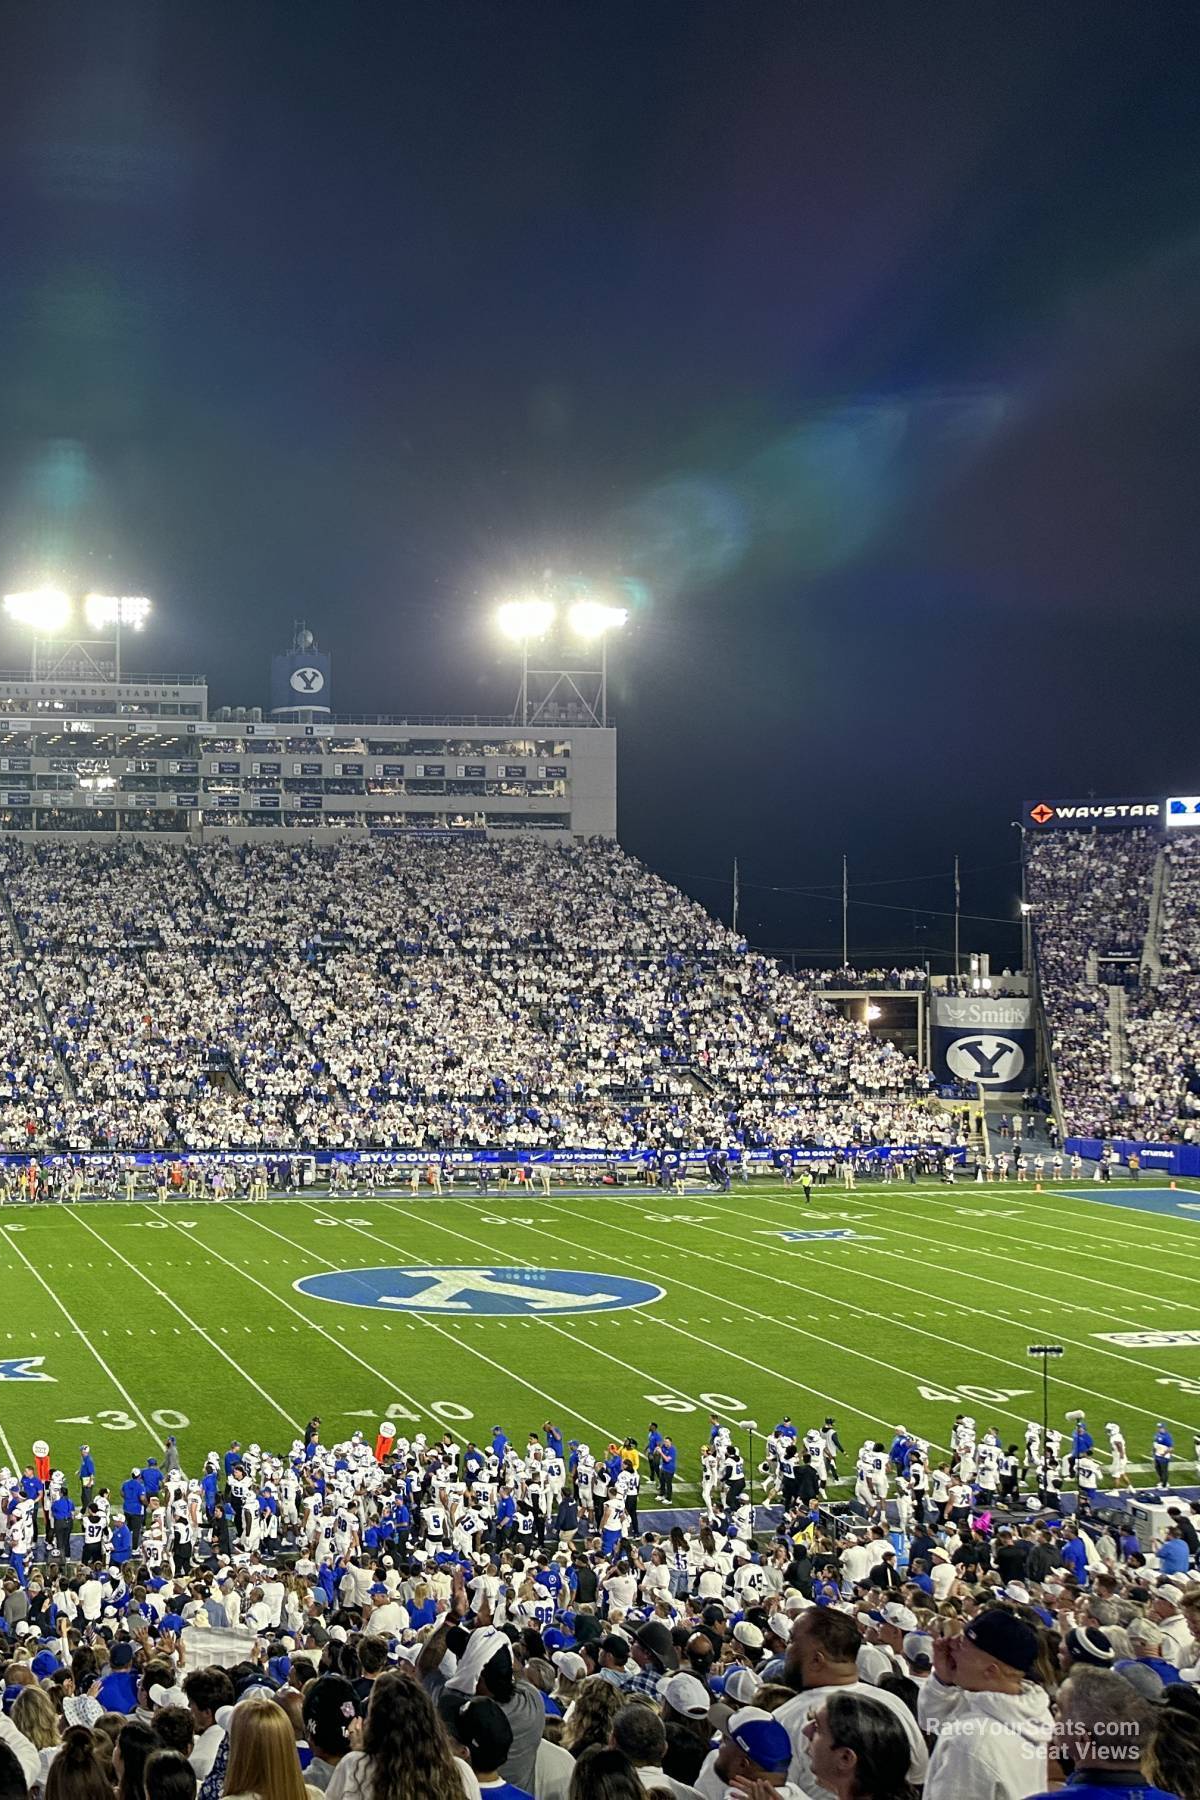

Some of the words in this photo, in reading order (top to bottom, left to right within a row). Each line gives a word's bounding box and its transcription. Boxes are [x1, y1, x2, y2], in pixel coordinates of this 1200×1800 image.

[395, 671, 419, 690] Y
[41, 688, 107, 697] EDWARDS
[117, 689, 181, 698] STADIUM
[1055, 804, 1160, 819] WAYSTAR
[968, 1004, 1026, 1023] Smith's
[957, 1040, 1014, 1079] Y
[187, 1155, 222, 1164] BYU
[360, 1154, 392, 1163] BYU
[395, 1154, 474, 1163] COUGARS
[1141, 1149, 1175, 1158] crumbl
[916, 1383, 1011, 1405] 40
[643, 1391, 748, 1414] 50
[96, 1408, 192, 1430] 30
[385, 1401, 475, 1423] 40
[233, 1486, 244, 1496] 51
[476, 1490, 489, 1502] 26
[432, 1515, 441, 1529] 5
[88, 1525, 101, 1538] 97
[748, 1573, 763, 1589] 45
[534, 1606, 553, 1625] 96
